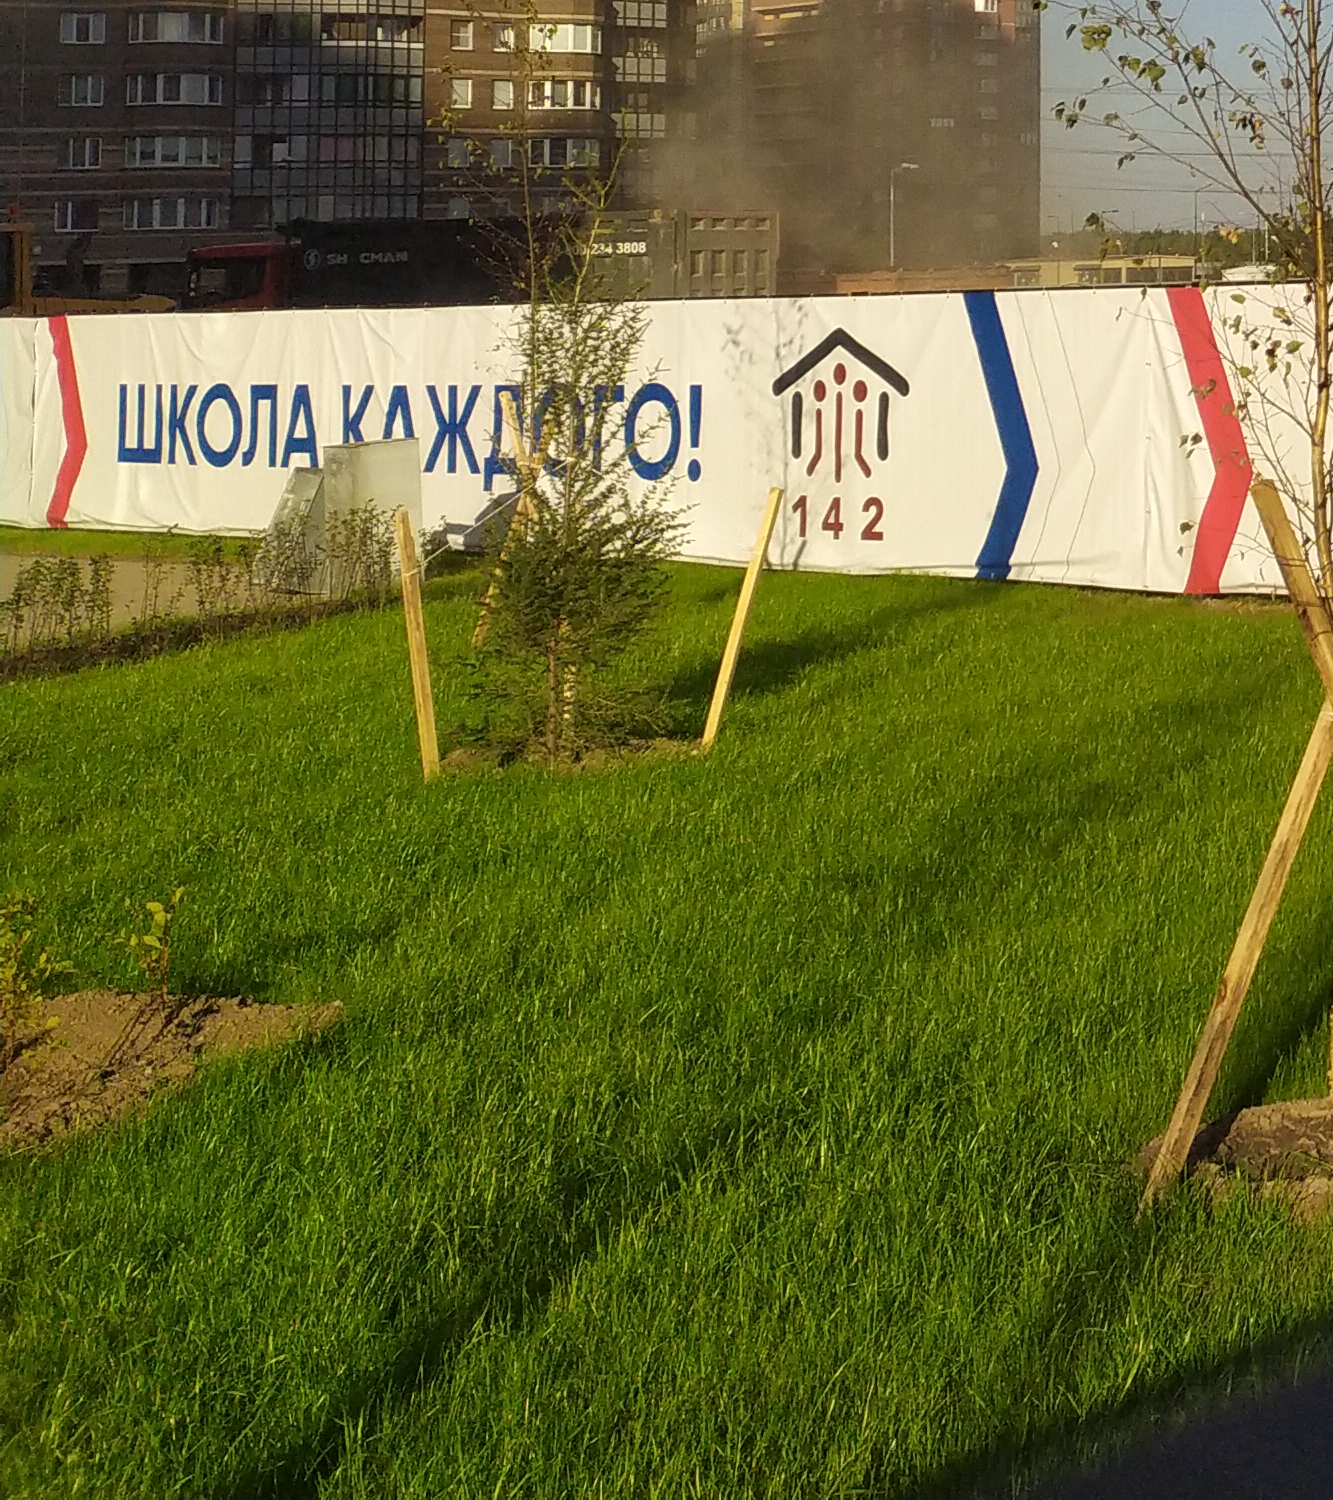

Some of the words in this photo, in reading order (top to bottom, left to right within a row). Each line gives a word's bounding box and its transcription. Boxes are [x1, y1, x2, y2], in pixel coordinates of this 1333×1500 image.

[326, 250, 409, 265] SHCMAN
[590, 243, 613, 255] 234
[616, 241, 647, 254] 3808
[118, 383, 320, 468] ШКОЛА
[792, 495, 885, 541] 142
